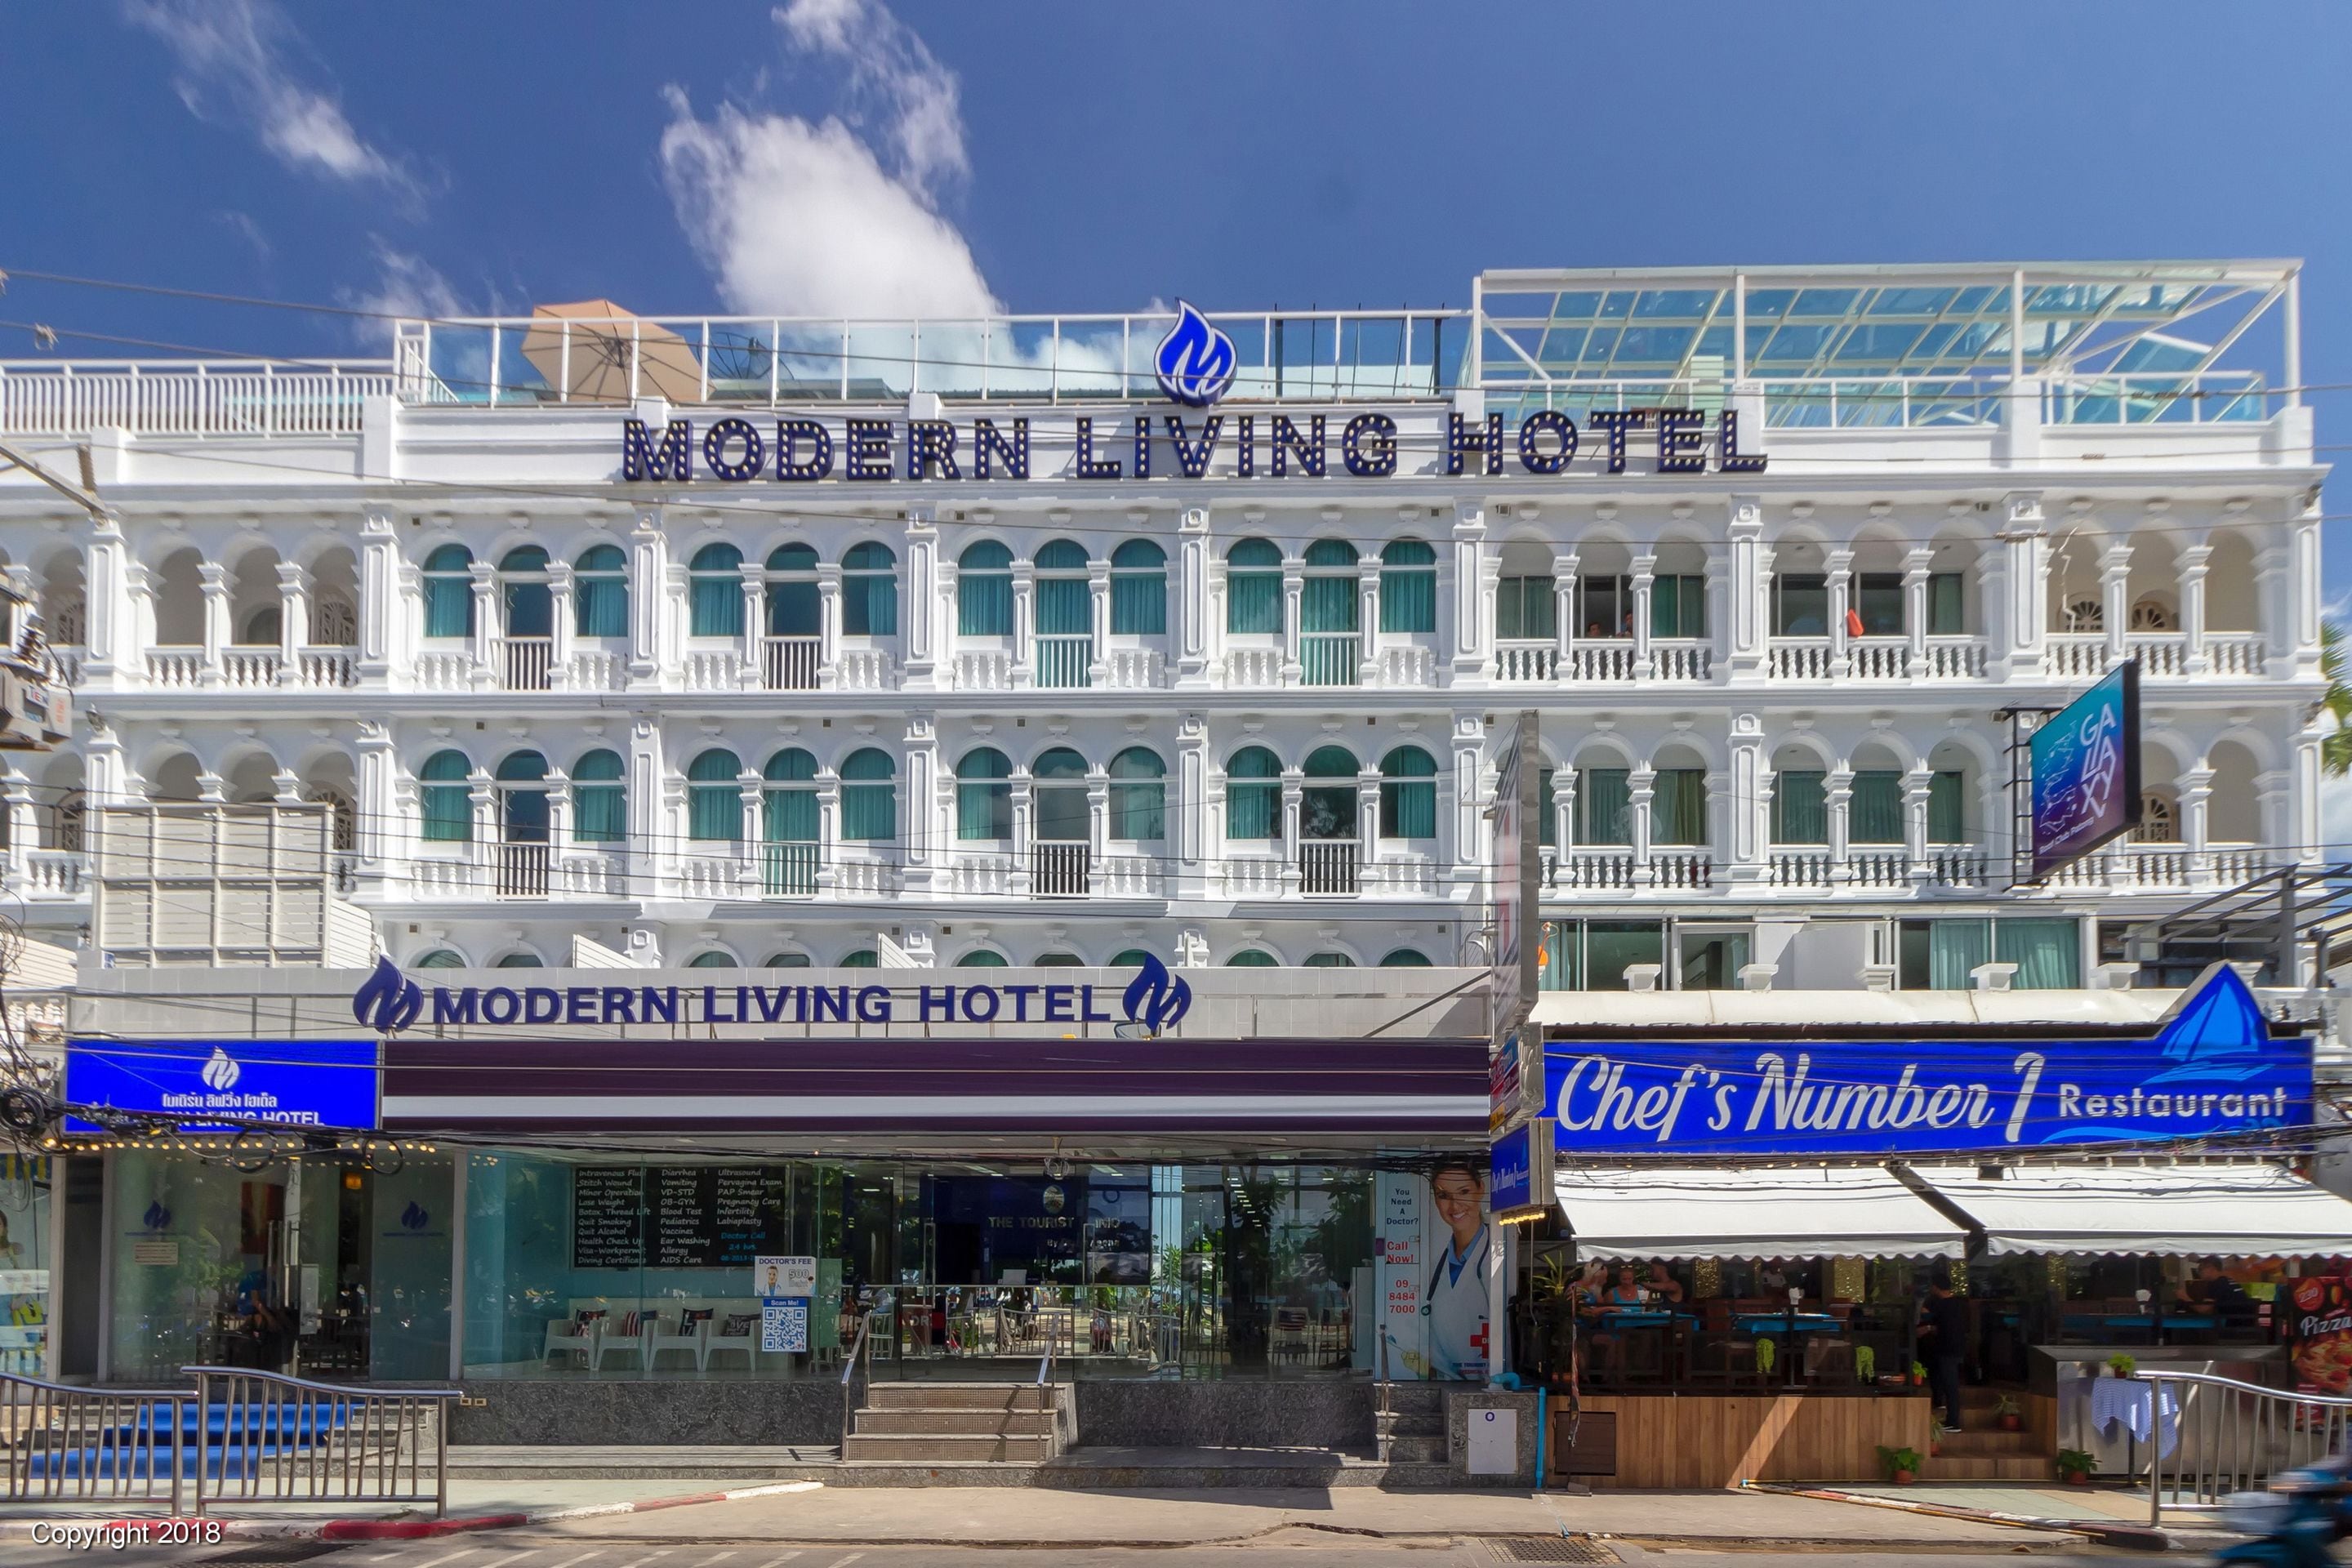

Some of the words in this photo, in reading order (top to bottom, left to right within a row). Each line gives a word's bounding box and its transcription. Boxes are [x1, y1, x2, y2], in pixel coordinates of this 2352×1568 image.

[622, 417, 1030, 481] MODERN
[1076, 412, 1398, 479] LIVING
[1449, 409, 1768, 474] HOTEL
[432, 986, 679, 1025] MODERN
[702, 985, 892, 1025] LIVING
[920, 983, 1111, 1023] HOTEL
[1557, 1054, 1737, 1143] Chef's
[1745, 1052, 1995, 1133] Number
[2006, 1052, 2047, 1143] 1
[2058, 1084, 2285, 1119] Restaurant
[662, 1169, 697, 1177] Diarrhea
[605, 1178, 633, 1187] Wound
[662, 1178, 697, 1187] Vomiting
[598, 1198, 625, 1208] Weight
[717, 1198, 760, 1207] Pregnancy
[637, 1207, 652, 1215] Lft
[717, 1208, 755, 1217] Infertility
[578, 1218, 595, 1227] Quit
[598, 1218, 632, 1227] Smoking
[716, 1218, 762, 1226] Labiaplasty
[988, 1216, 1013, 1228] THE
[1020, 1216, 1075, 1228] TOURIST
[1387, 1217, 1419, 1225] Doctor?
[677, 1237, 710, 1246] Washing
[1387, 1241, 1408, 1251] Call
[660, 1246, 688, 1255] Allergy
[577, 1256, 603, 1266] Diving
[604, 1256, 647, 1264] Certificae
[1387, 1254, 1414, 1263] Now!
[788, 1268, 809, 1279] 500
[1396, 1279, 1409, 1288] 09
[1389, 1292, 1415, 1301] 8484
[1389, 1305, 1415, 1314] 7000
[2300, 1315, 2352, 1336] Pizza
